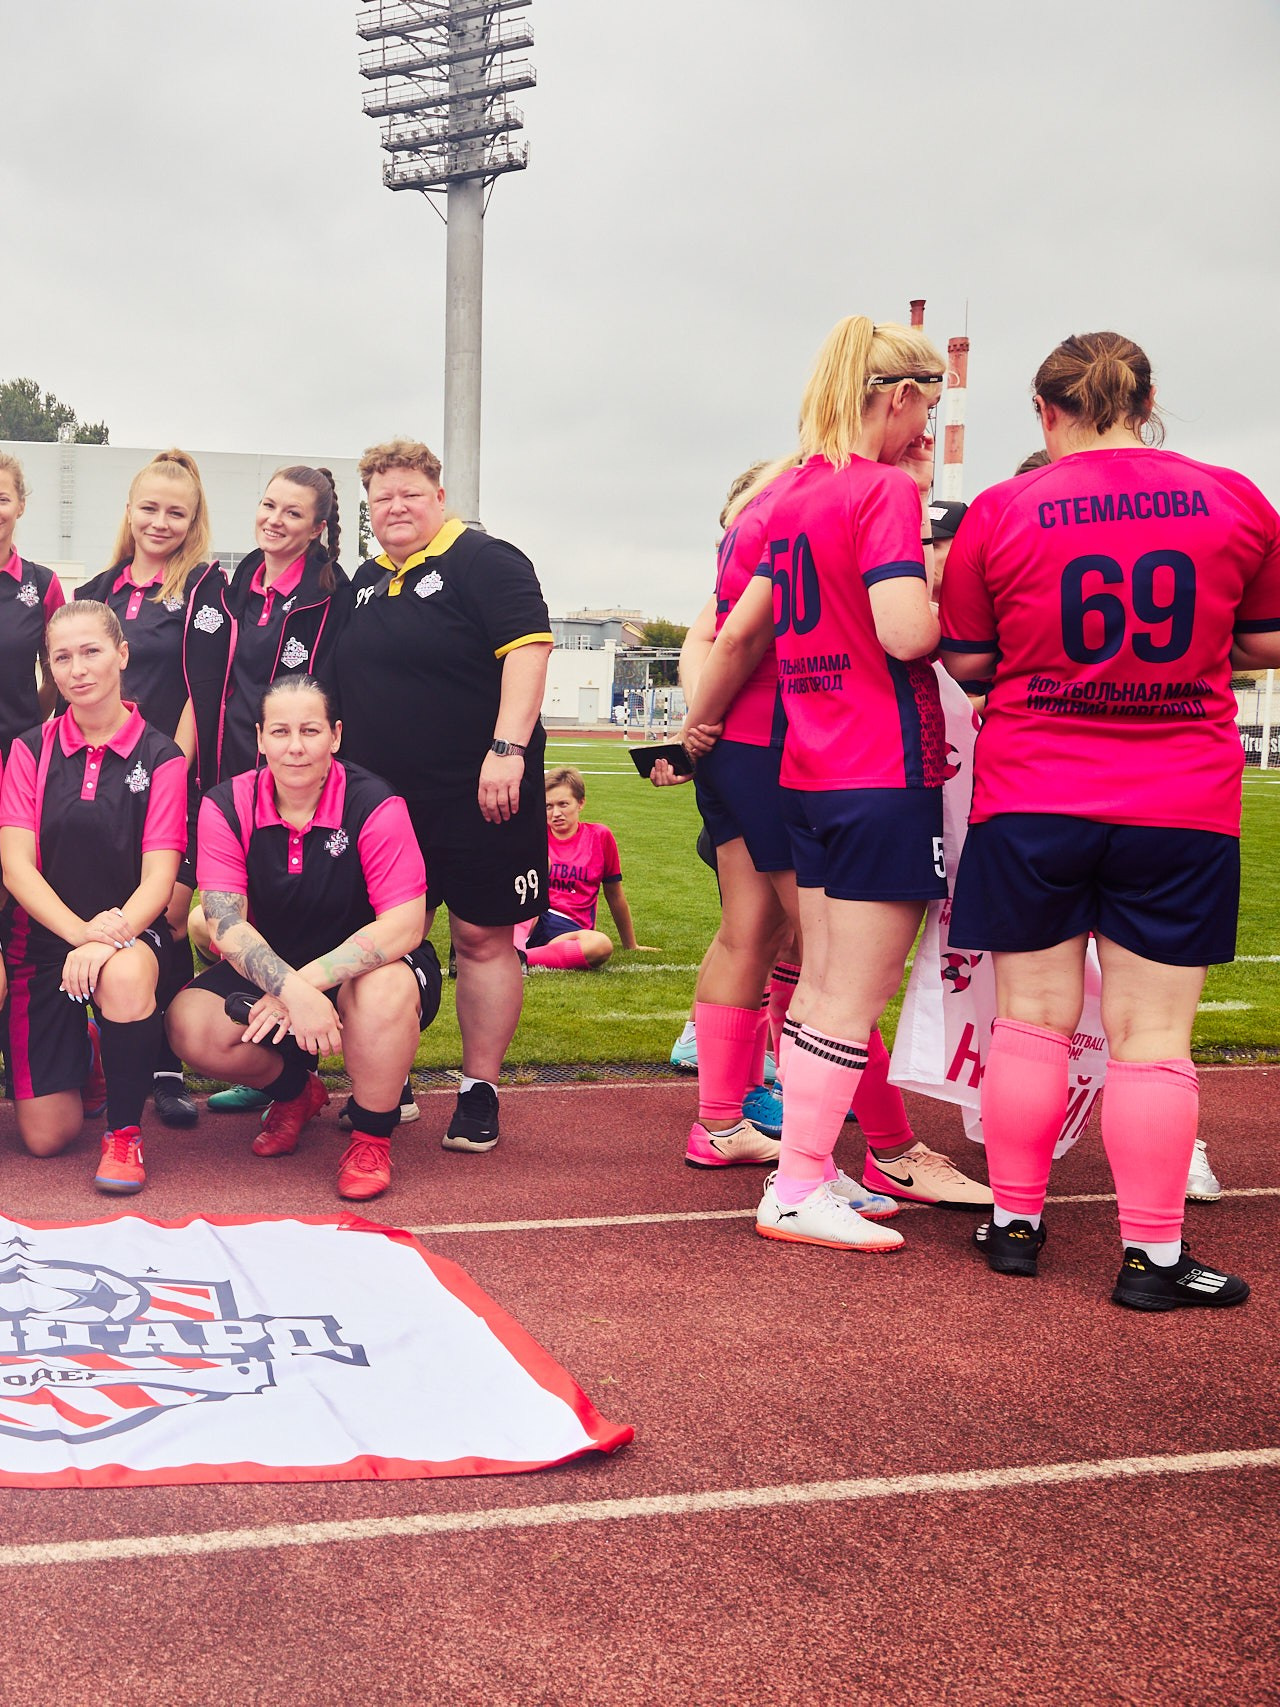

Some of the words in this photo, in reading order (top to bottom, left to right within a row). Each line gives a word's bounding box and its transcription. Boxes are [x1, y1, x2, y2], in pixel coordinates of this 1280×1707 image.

[1038, 490, 1210, 529] СТЕМАСОВА
[770, 532, 821, 638] 50
[1061, 549, 1197, 665] 69
[807, 653, 851, 673] МАМА
[1164, 678, 1214, 699] МАМА
[514, 869, 539, 905] 99
[548, 863, 589, 883] TBALL
[1071, 1032, 1106, 1051] OTBALL
